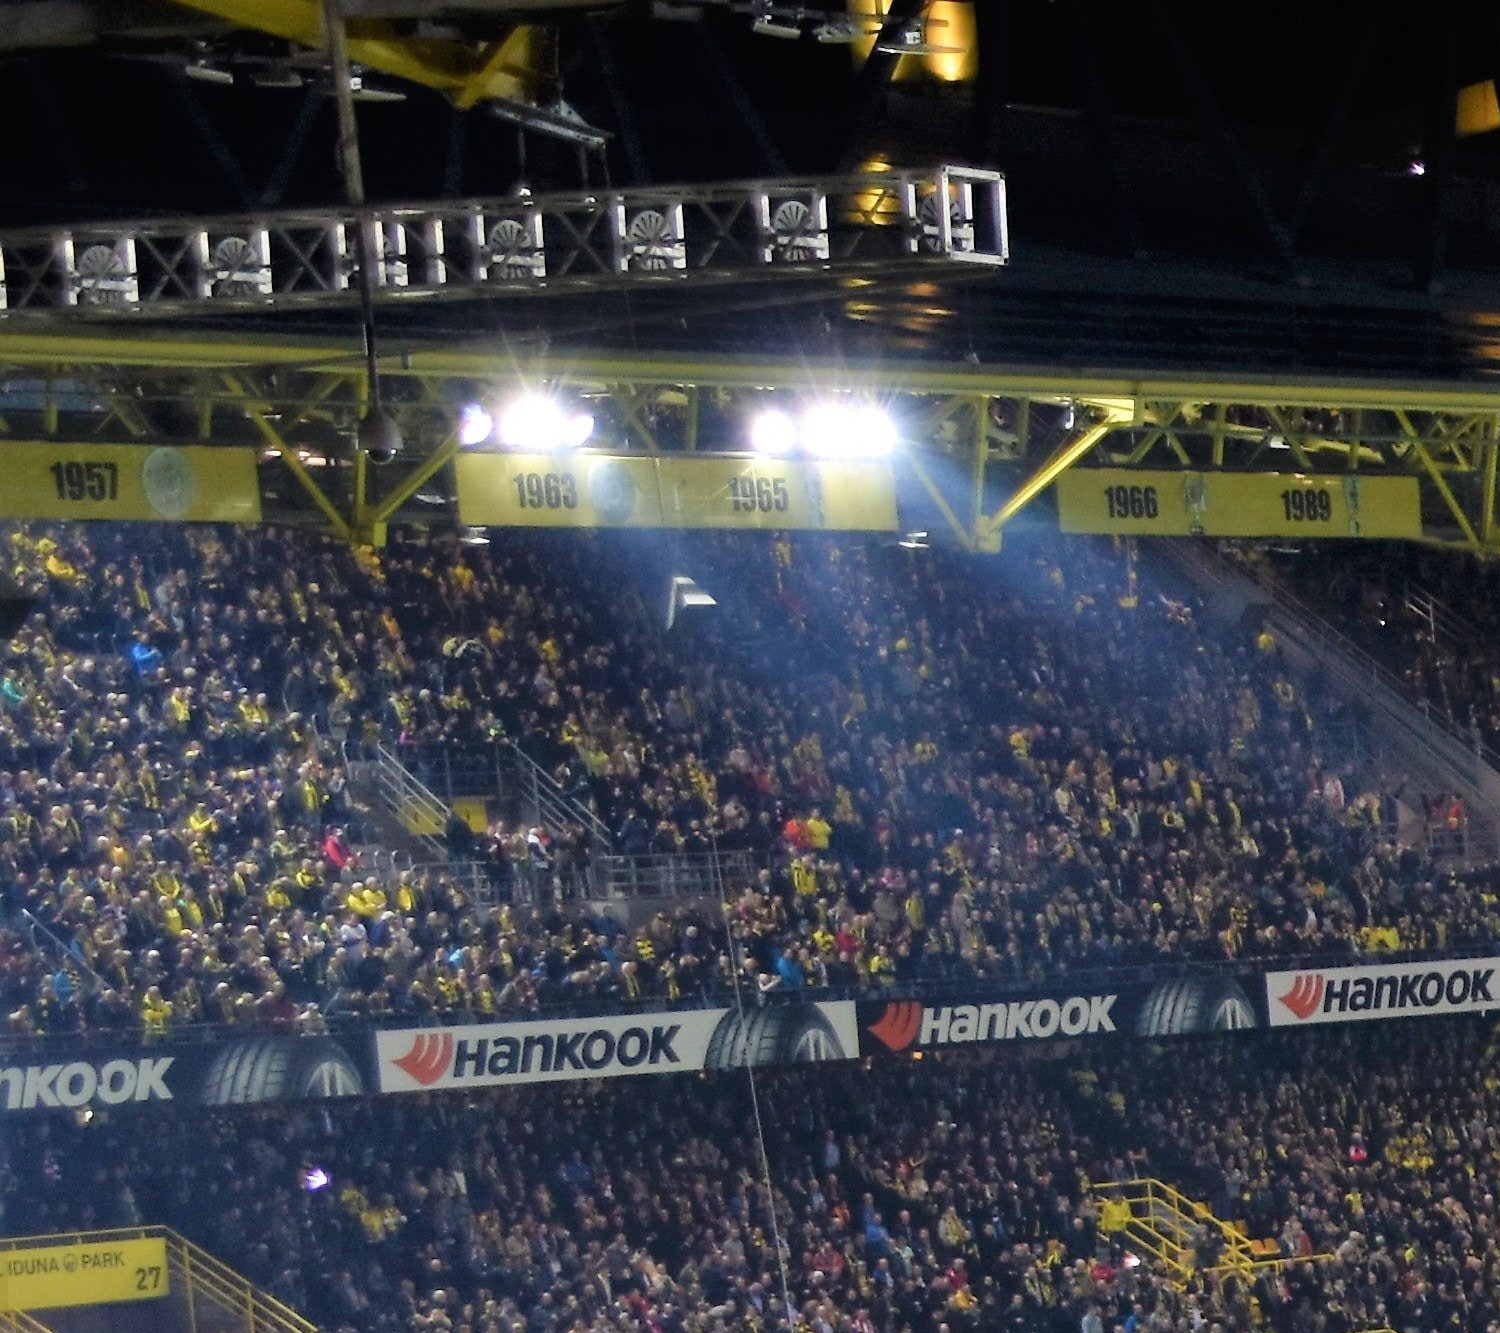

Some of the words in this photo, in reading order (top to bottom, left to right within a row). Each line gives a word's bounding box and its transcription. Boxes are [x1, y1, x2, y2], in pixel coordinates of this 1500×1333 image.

[50, 460, 119, 500] 1957
[513, 472, 579, 509] 1963
[728, 476, 790, 512] 1965
[1104, 485, 1158, 519] 1966
[1280, 489, 1332, 522] 1989
[8, 1257, 59, 1276] IDUNA
[80, 1251, 125, 1269] PARK
[135, 1266, 162, 1291] 27
